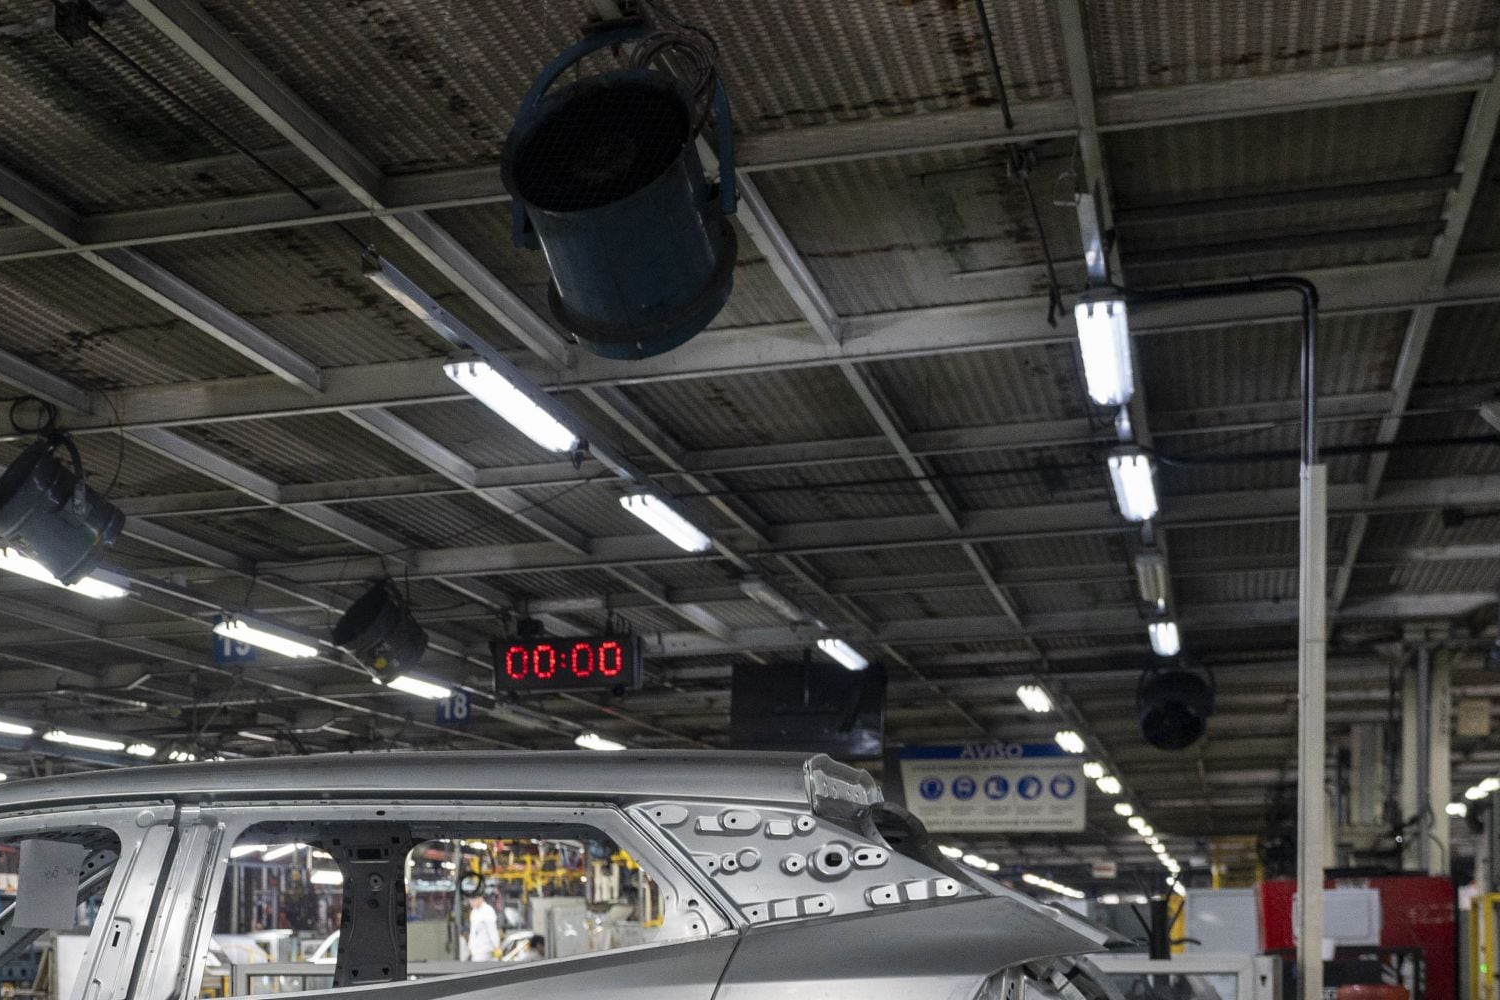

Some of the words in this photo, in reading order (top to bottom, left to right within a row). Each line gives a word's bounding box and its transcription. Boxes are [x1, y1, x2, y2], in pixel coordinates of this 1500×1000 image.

[505, 641, 622, 680] 00:00
[440, 692, 468, 720] 18
[961, 742, 1023, 760] AVISO
